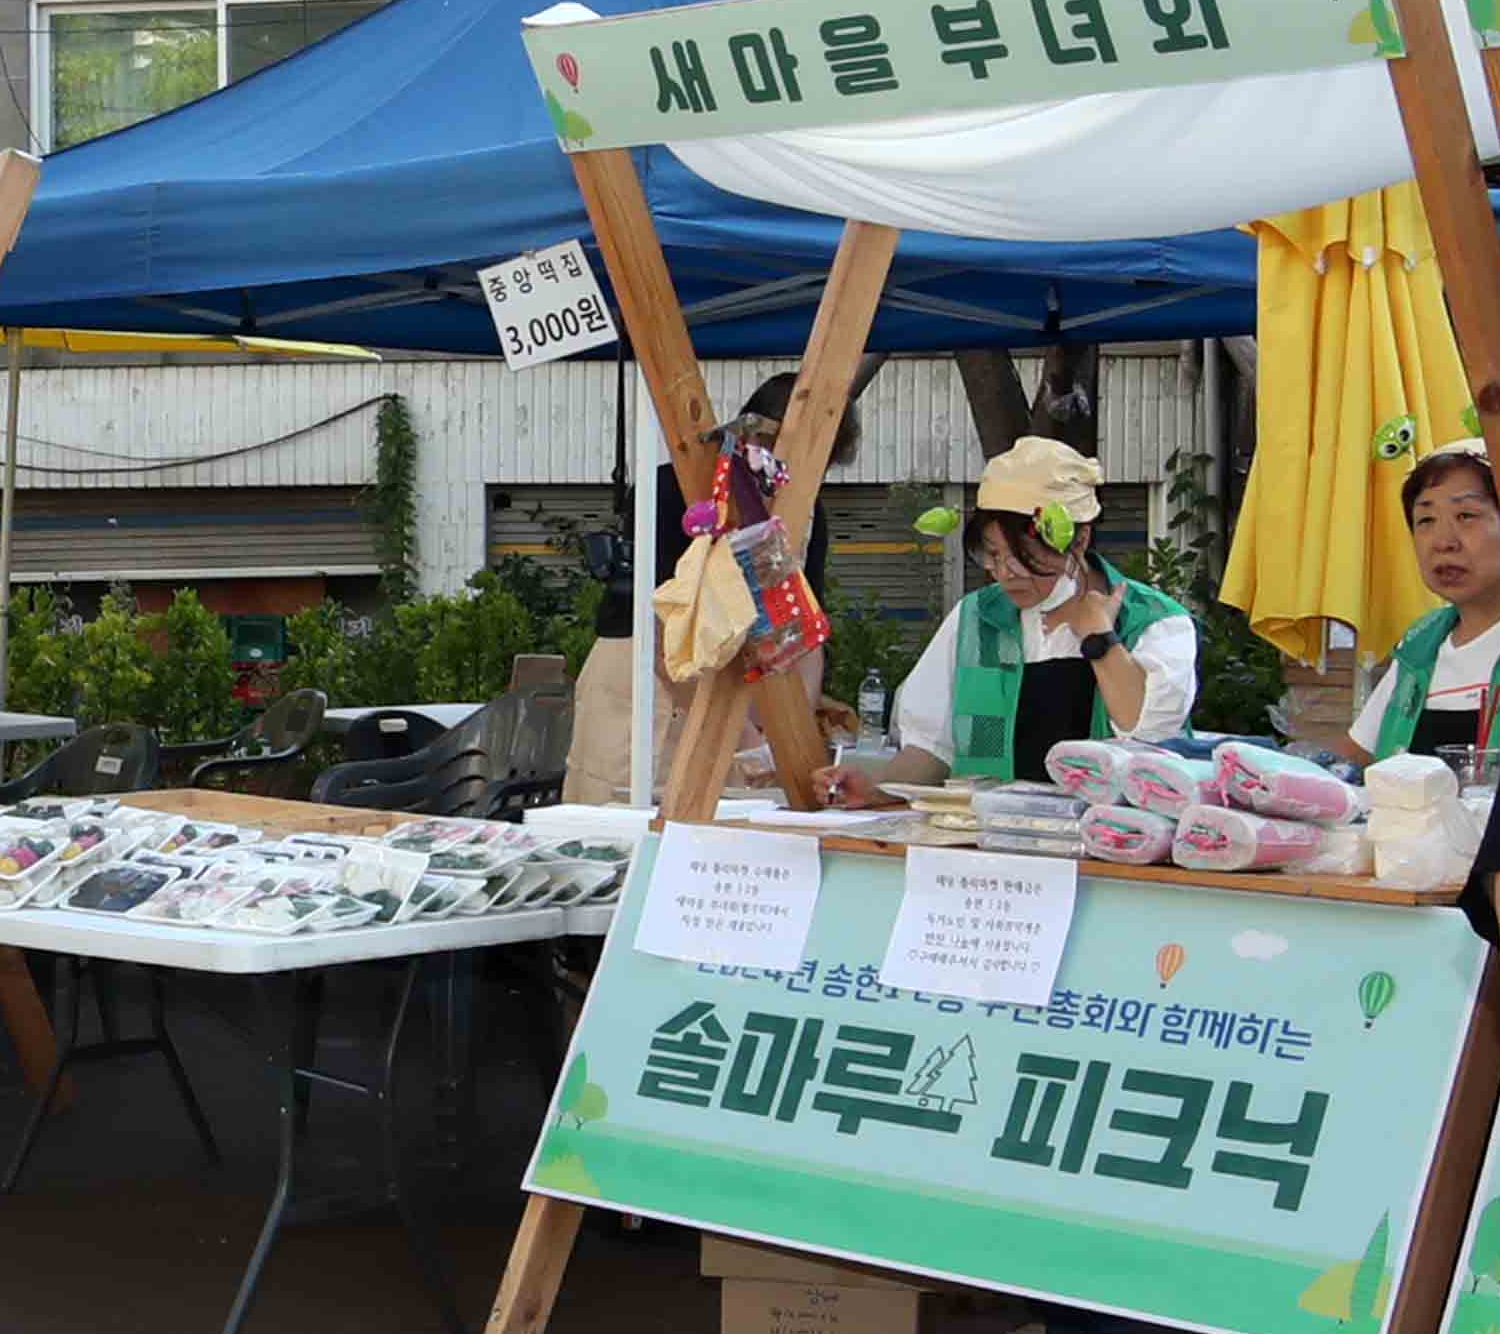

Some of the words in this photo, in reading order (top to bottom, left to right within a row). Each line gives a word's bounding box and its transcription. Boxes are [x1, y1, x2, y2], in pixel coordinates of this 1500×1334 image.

[649, 14, 900, 115] 새마을
[505, 294, 609, 356] 3,000원
[1160, 1005, 1312, 1062] 함께하는
[637, 1002, 963, 1137] 솔마루
[991, 1052, 1331, 1211] 피크닉
